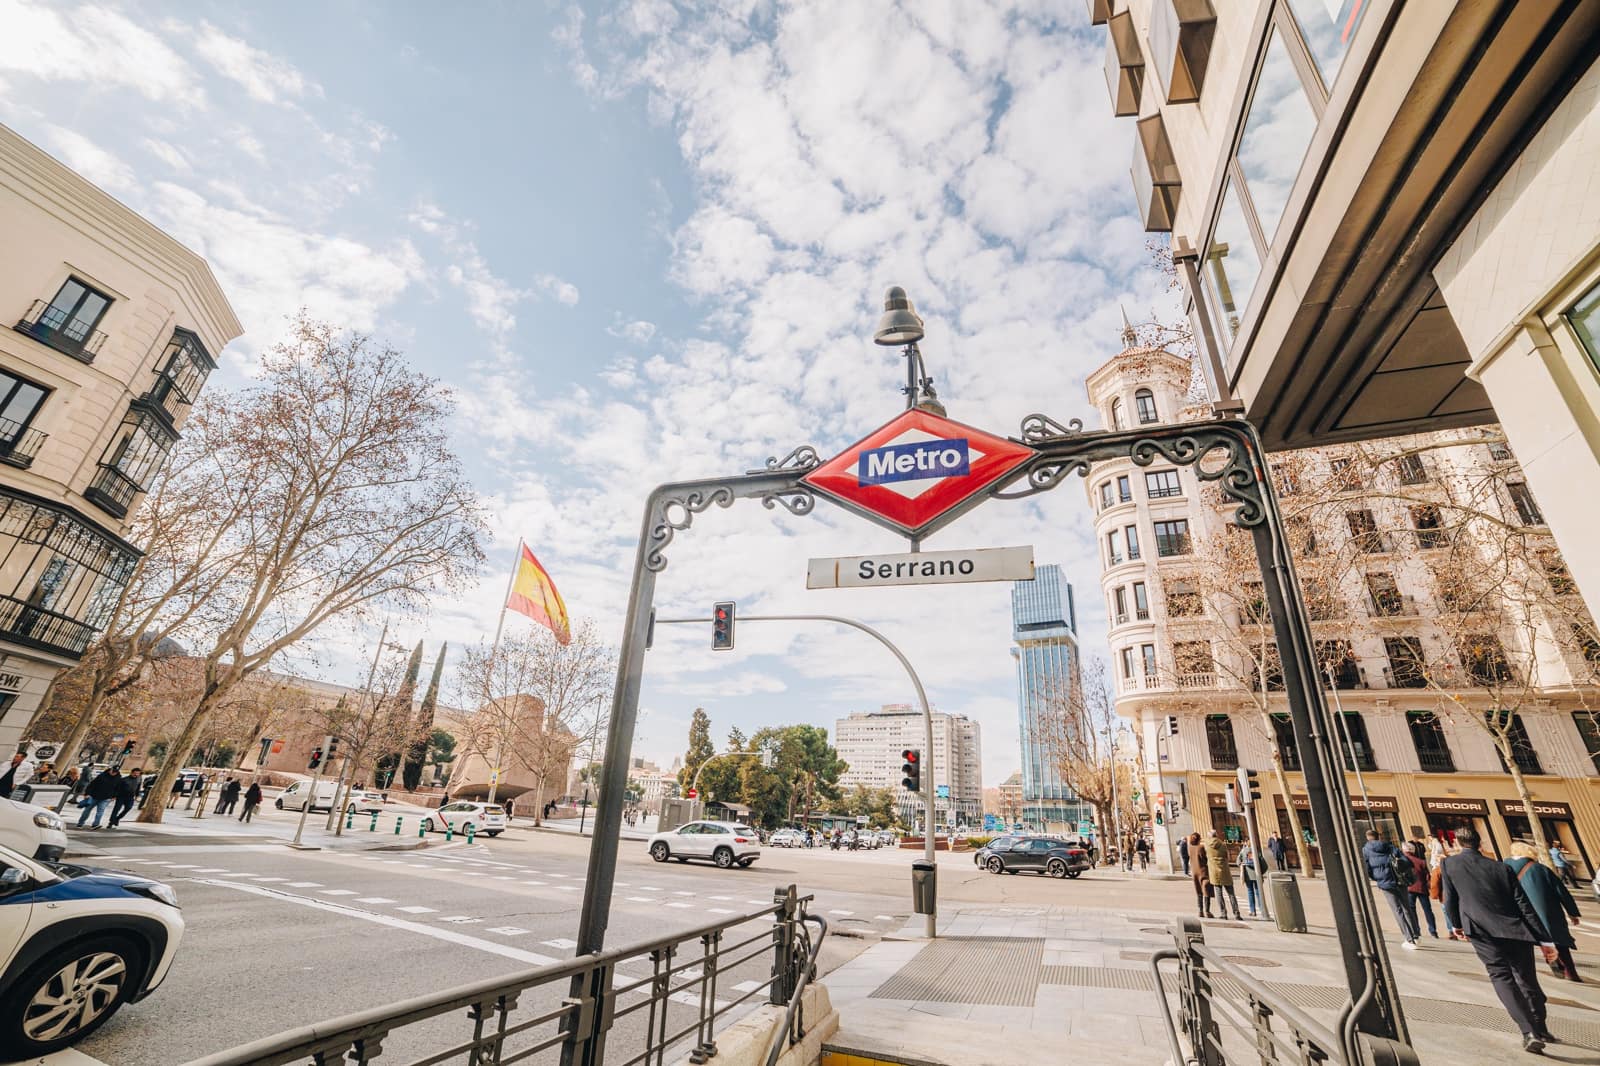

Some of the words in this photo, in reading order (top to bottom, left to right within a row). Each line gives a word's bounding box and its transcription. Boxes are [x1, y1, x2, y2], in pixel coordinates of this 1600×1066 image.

[868, 448, 962, 477] Metro
[858, 558, 975, 579] Serrano
[1350, 800, 1393, 808] ERODRI
[1427, 802, 1482, 810] PERODRI
